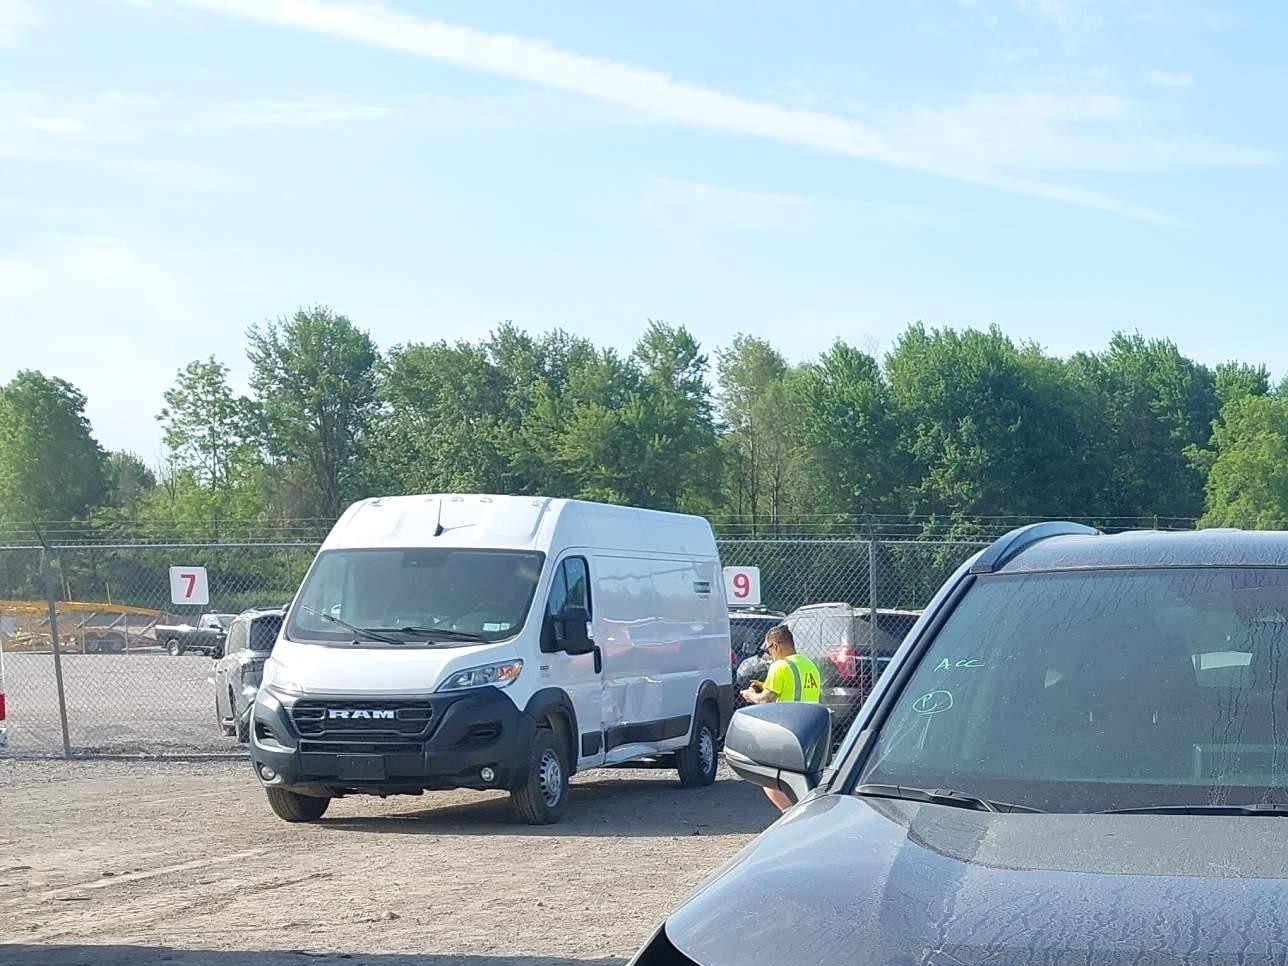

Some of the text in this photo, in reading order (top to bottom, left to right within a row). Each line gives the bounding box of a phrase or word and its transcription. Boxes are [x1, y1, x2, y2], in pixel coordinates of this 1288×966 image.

[180, 574, 196, 599] 7
[733, 573, 750, 598] 9
[328, 708, 395, 719] RAM
